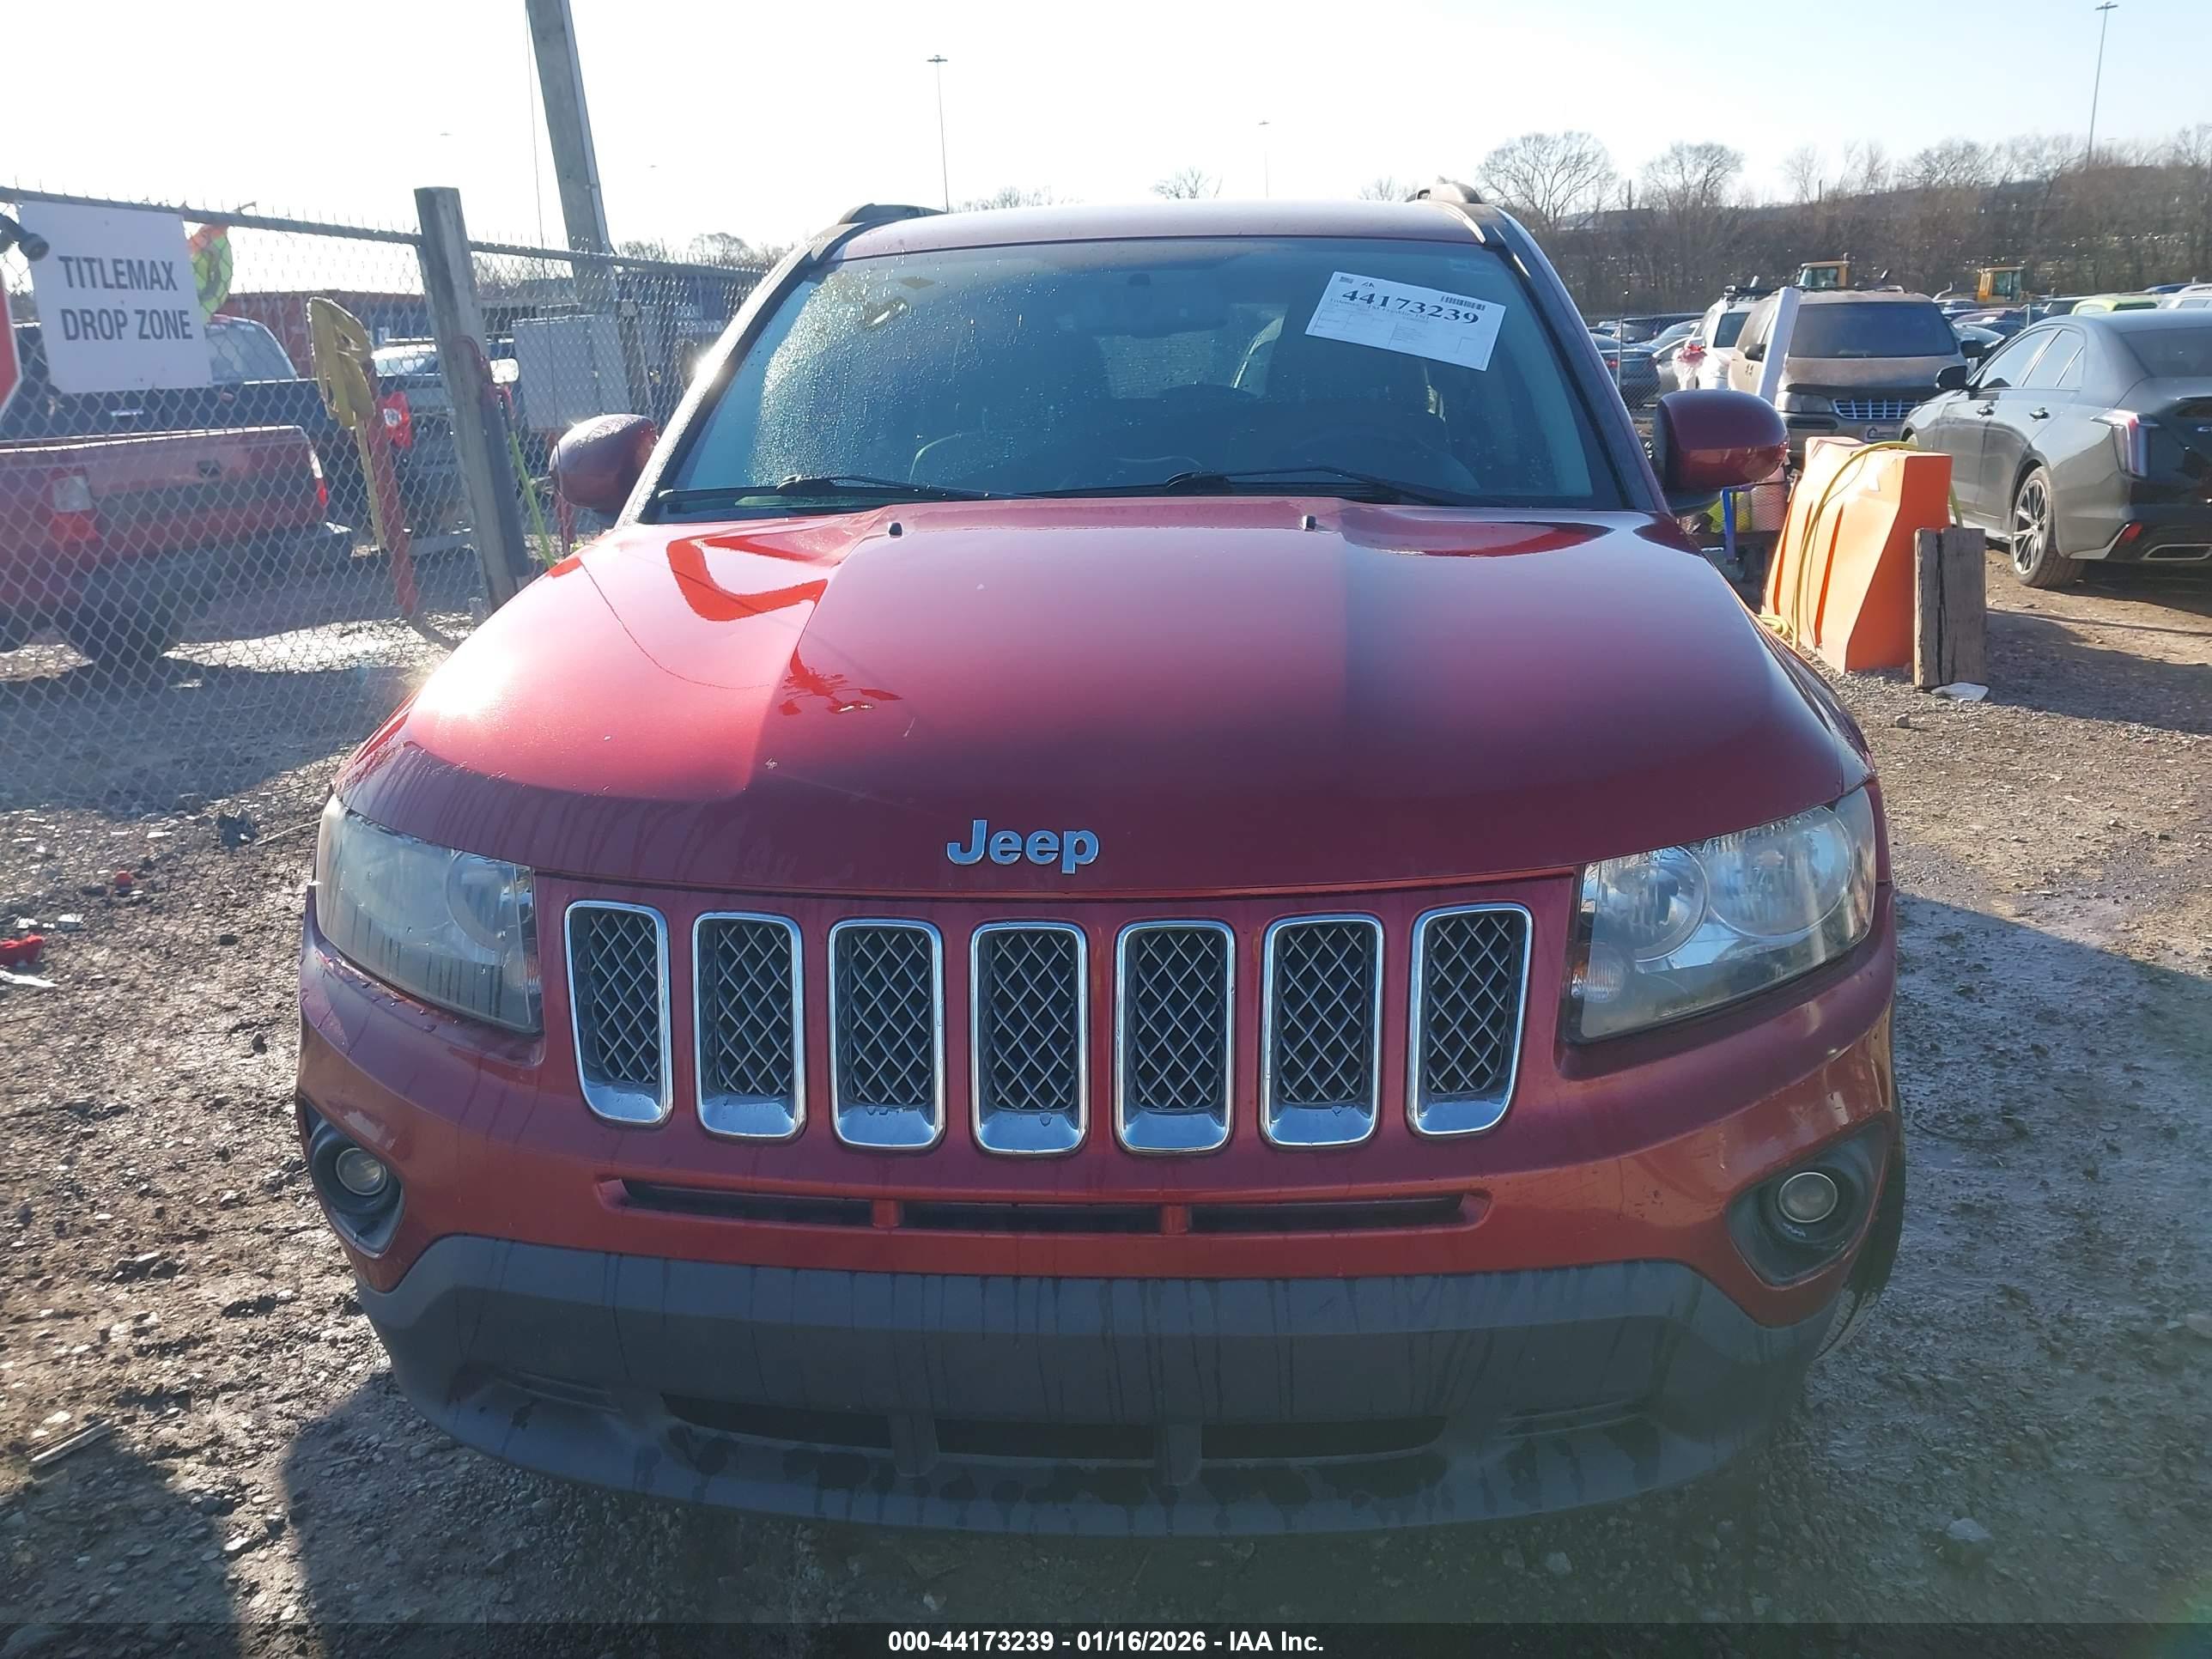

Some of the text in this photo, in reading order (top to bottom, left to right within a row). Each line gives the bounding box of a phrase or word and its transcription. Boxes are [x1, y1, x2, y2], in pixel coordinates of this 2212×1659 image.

[58, 256, 179, 291] TITLEMAX
[60, 308, 193, 341] DROP ZONE
[1341, 289, 1480, 325] 44173239
[946, 818, 1100, 874] Jeep
